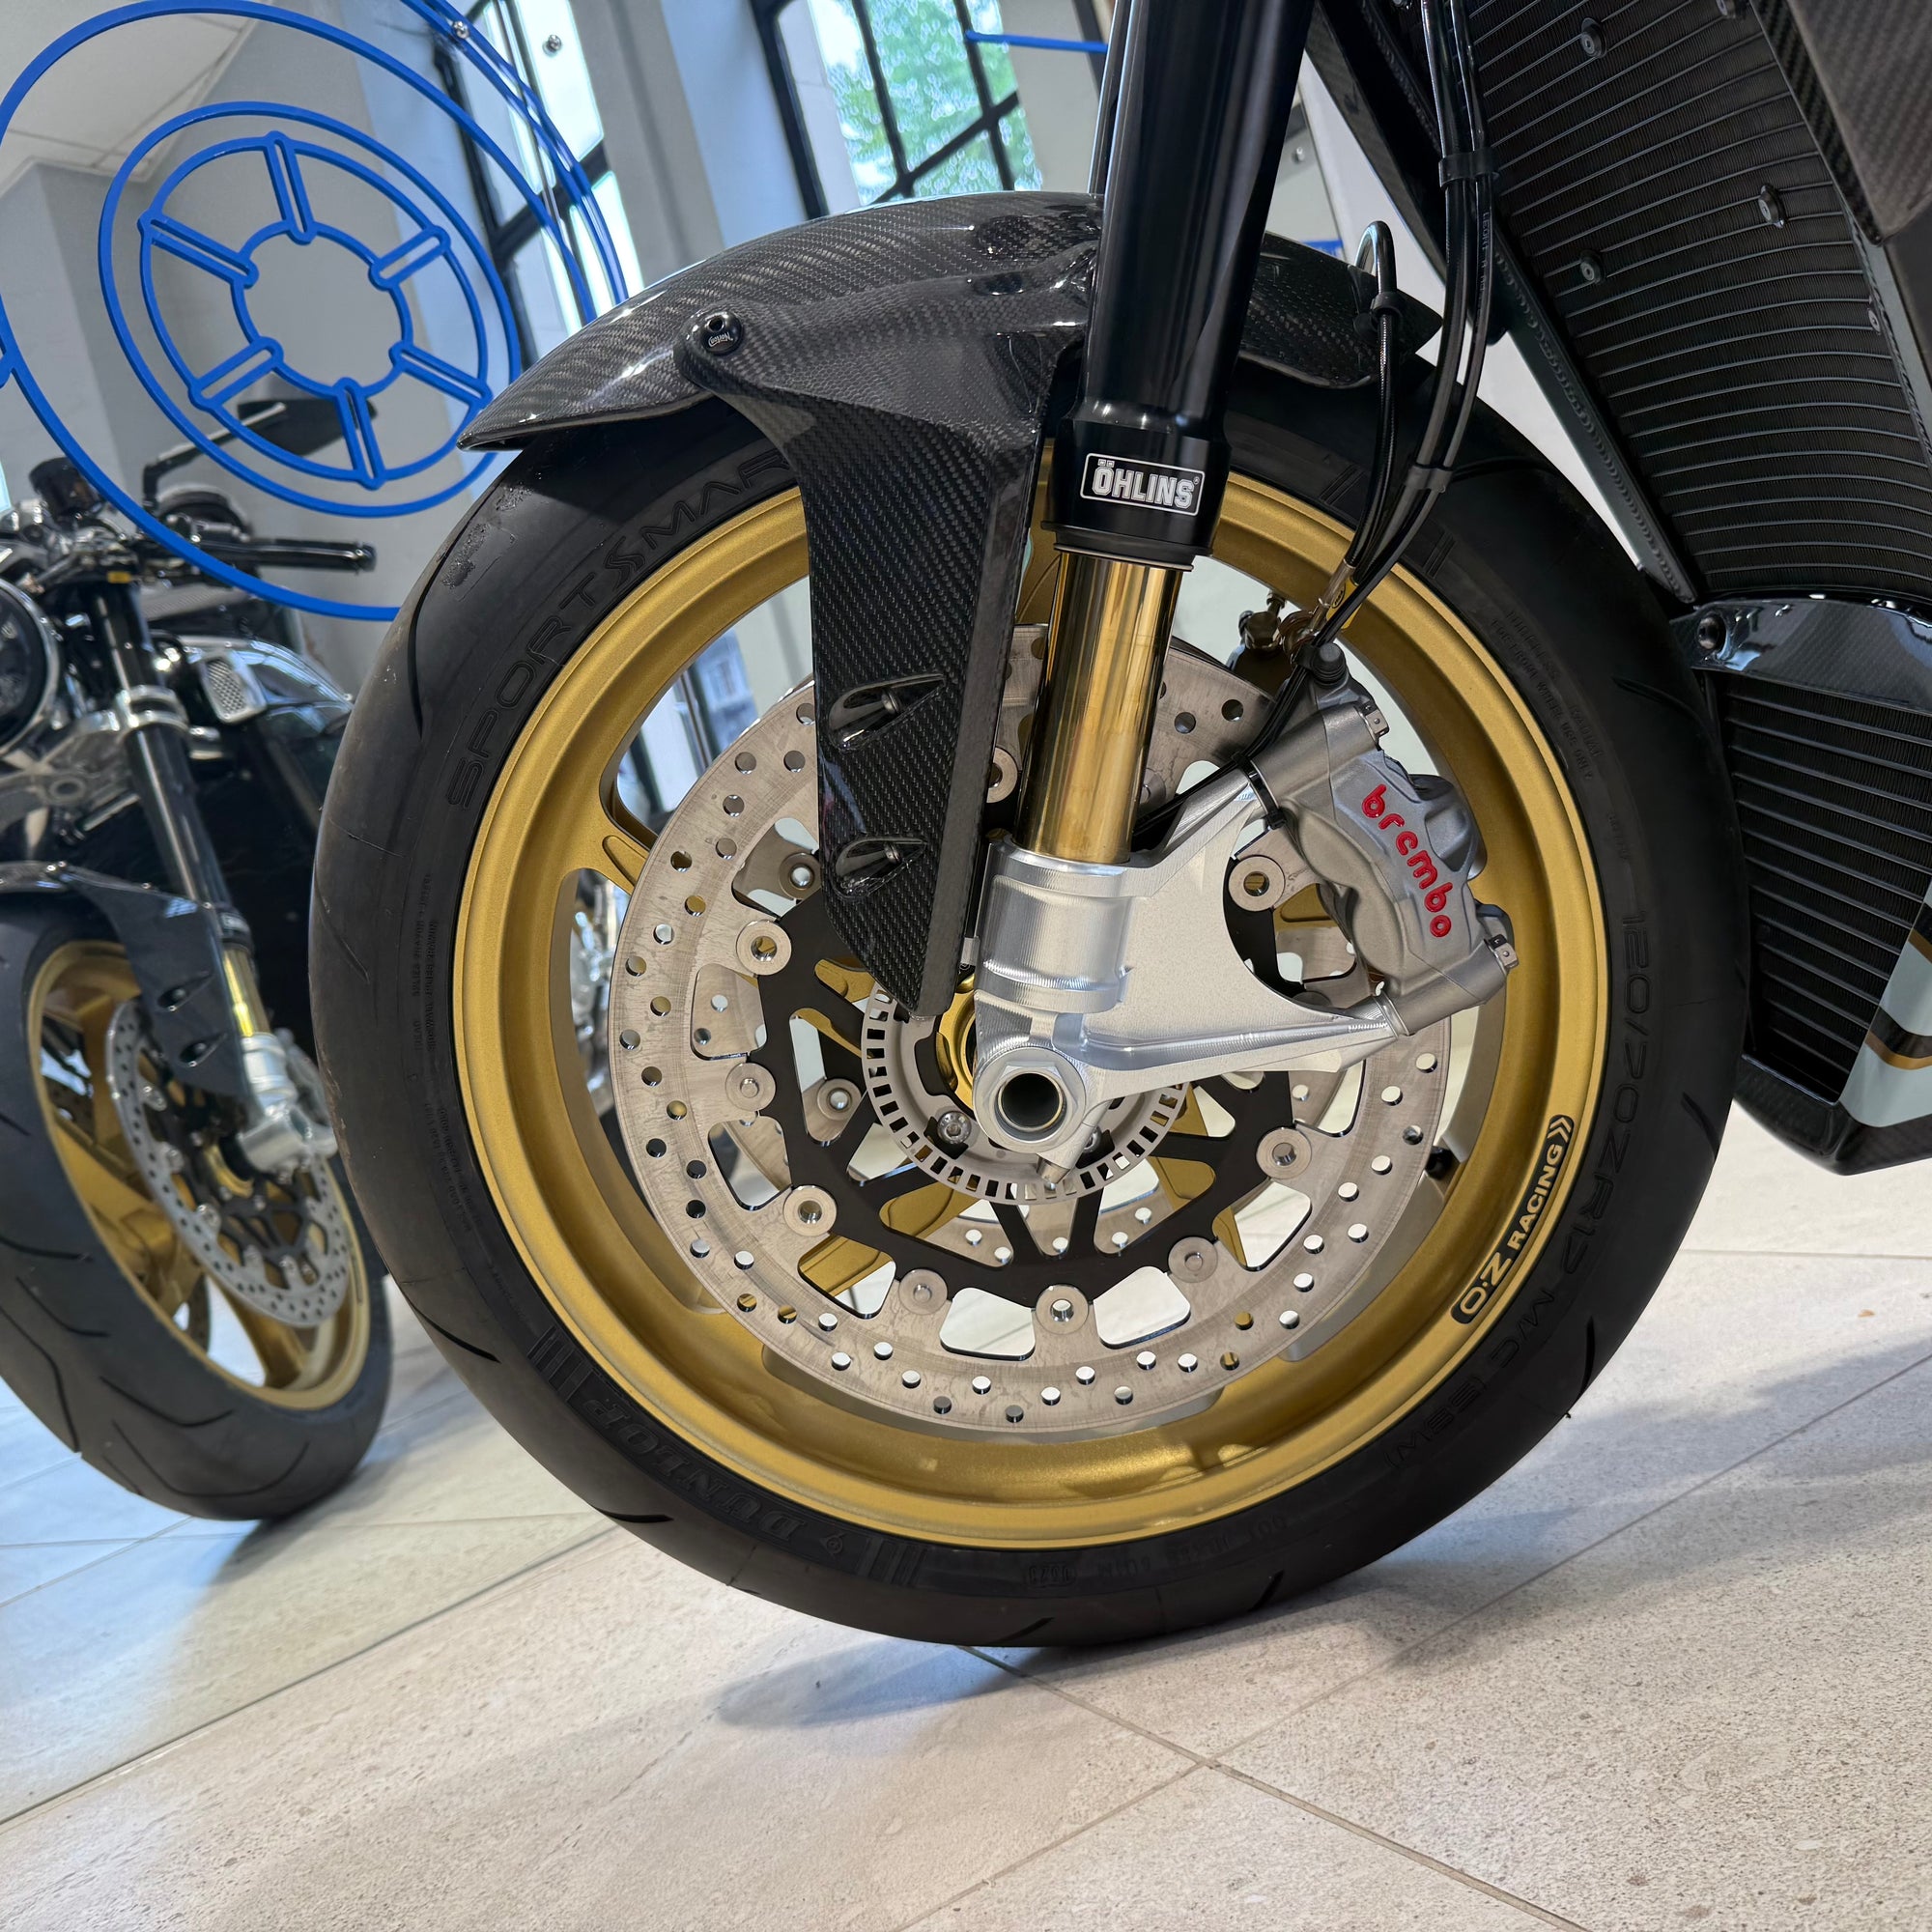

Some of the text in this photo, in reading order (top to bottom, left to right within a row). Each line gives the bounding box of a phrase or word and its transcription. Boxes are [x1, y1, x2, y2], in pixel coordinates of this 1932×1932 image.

[444, 446, 792, 811] SPORTSMAR
[1362, 783, 1453, 938] brembo
[1506, 1144, 1564, 1251] RACING
